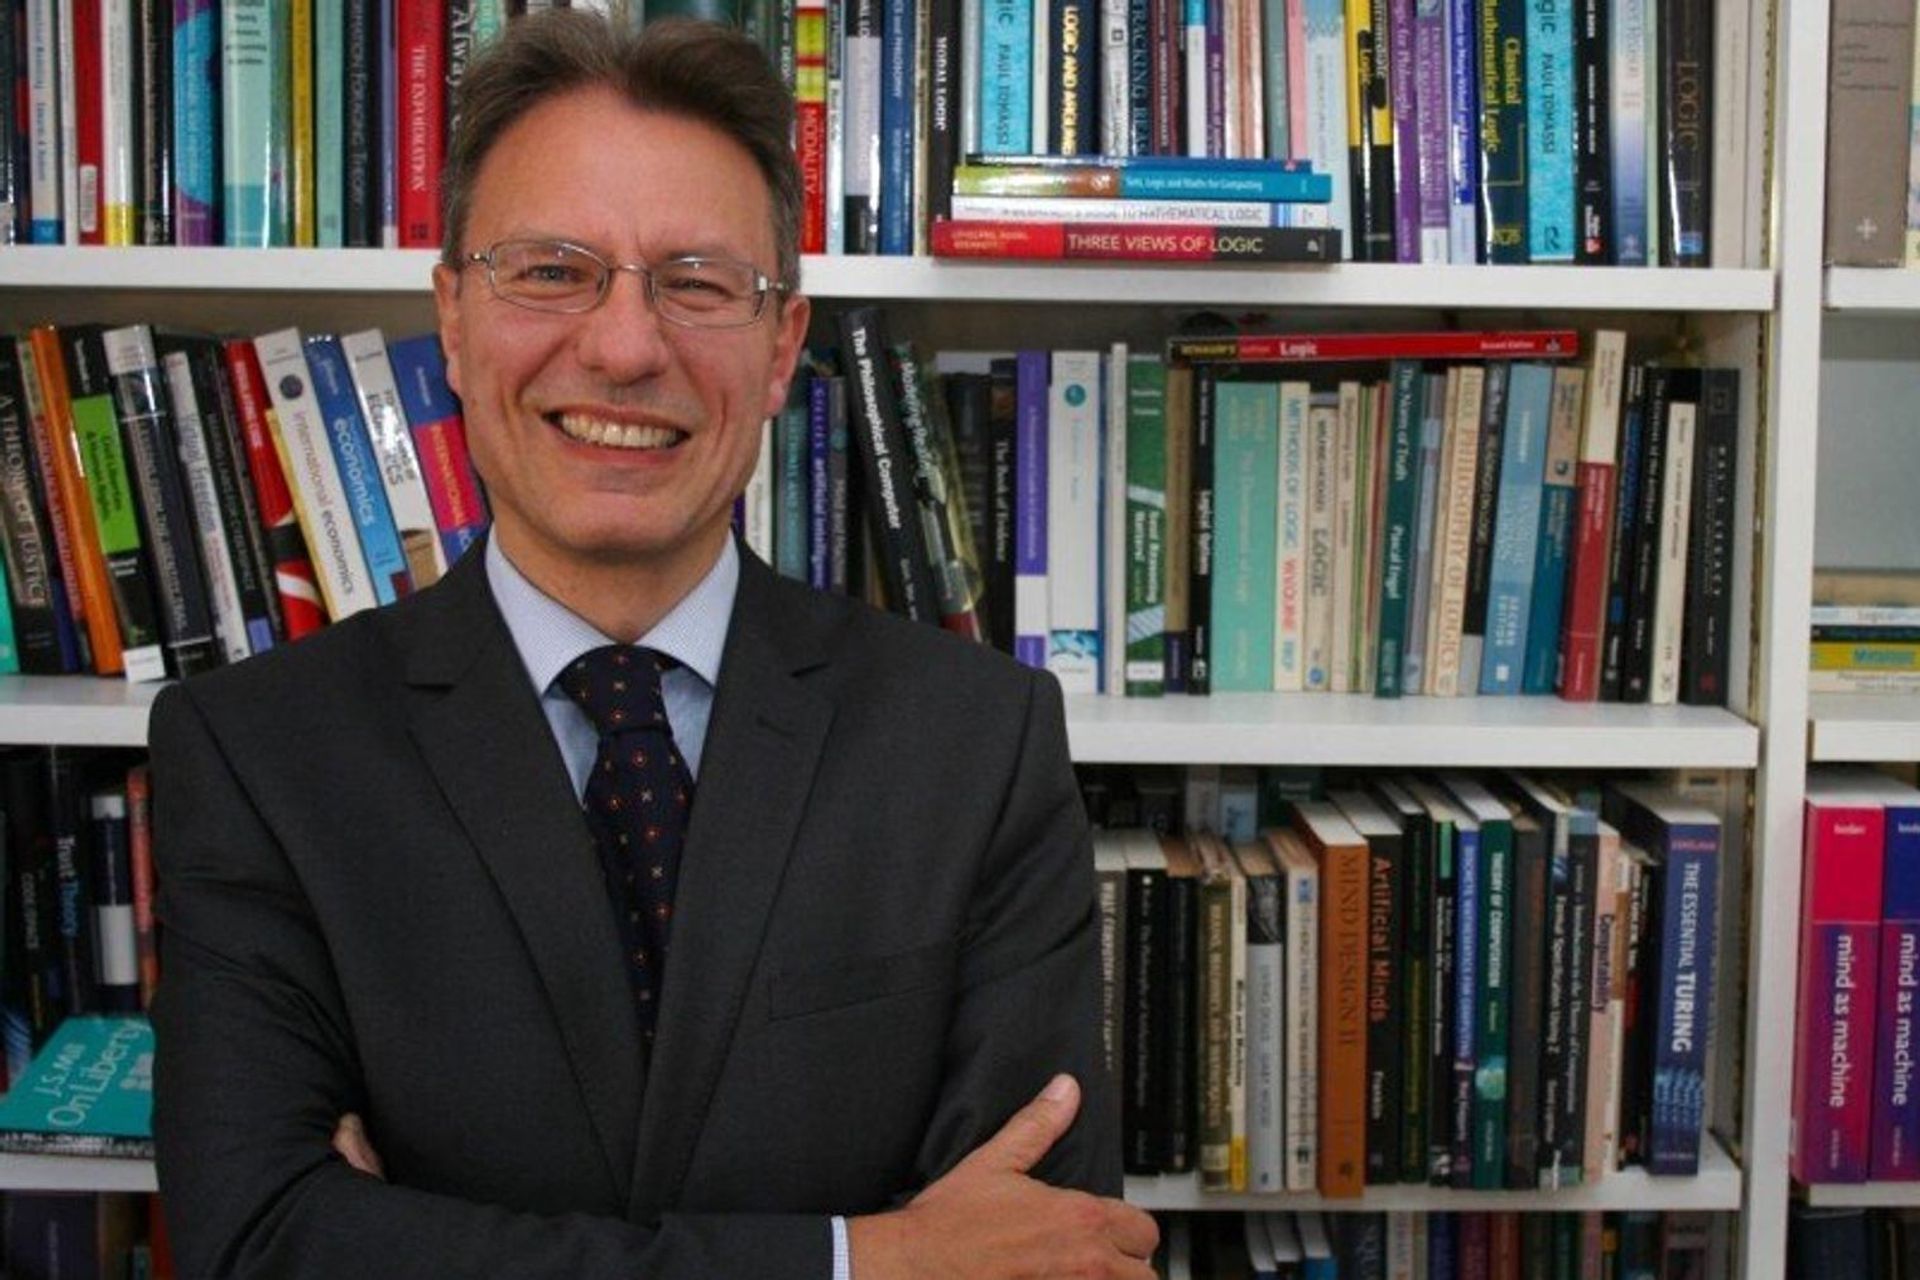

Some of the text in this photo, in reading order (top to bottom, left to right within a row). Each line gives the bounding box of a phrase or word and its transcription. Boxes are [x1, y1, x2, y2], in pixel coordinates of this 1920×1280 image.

[892, 37, 903, 98] PHILOSOPHY
[1062, 7, 1079, 87] LOGIC AND
[1505, 37, 1521, 104] Classical
[411, 45, 427, 191] THE INFORMATION
[935, 37, 947, 131] MODAL LOGIC
[997, 44, 1011, 145] PAUL TOMASSI
[1397, 50, 1411, 121] Philosophy
[1543, 53, 1555, 154] PAUL TOMASSI
[1676, 61, 1700, 150] LOGIC
[803, 108, 818, 194] MODALITY
[1484, 109, 1499, 153] Logic
[1068, 233, 1264, 253] THREE VIEWS OF LOGIC
[1278, 342, 1318, 356] Logic
[1400, 368, 1413, 390] The
[1649, 398, 1663, 443] Sciences
[1653, 379, 1664, 396] The
[851, 327, 902, 530] The Philosophical Computer
[1393, 447, 1410, 481] Truth
[1395, 430, 1410, 446] of
[1648, 445, 1660, 456] of
[292, 409, 357, 597] international economics
[332, 415, 379, 527] economics
[427, 422, 469, 526] INTERNATIONAL
[814, 457, 825, 515] artificial
[0, 410, 28, 493] THEORY
[16, 530, 49, 611] JUSTICE
[1285, 502, 1298, 546] LOGIC
[1311, 528, 1328, 597] LOGIC
[56, 835, 81, 937] Trust Theory
[1100, 881, 1115, 913] WHAT
[1340, 854, 1359, 925] MIND
[1682, 860, 1700, 890] THE
[1369, 857, 1394, 1022] Artificial Minds
[1552, 895, 1567, 935] Formal
[1677, 891, 1699, 968] ESSENTIAL
[1339, 932, 1358, 1021] DESIGN
[1549, 937, 1565, 1008] Specification
[1591, 912, 1616, 1014] Computability
[1670, 970, 1696, 1053] TURING
[1829, 934, 1859, 1108] mind as machine
[1891, 932, 1920, 1107] mind as machine
[46, 1093, 97, 1127] On
